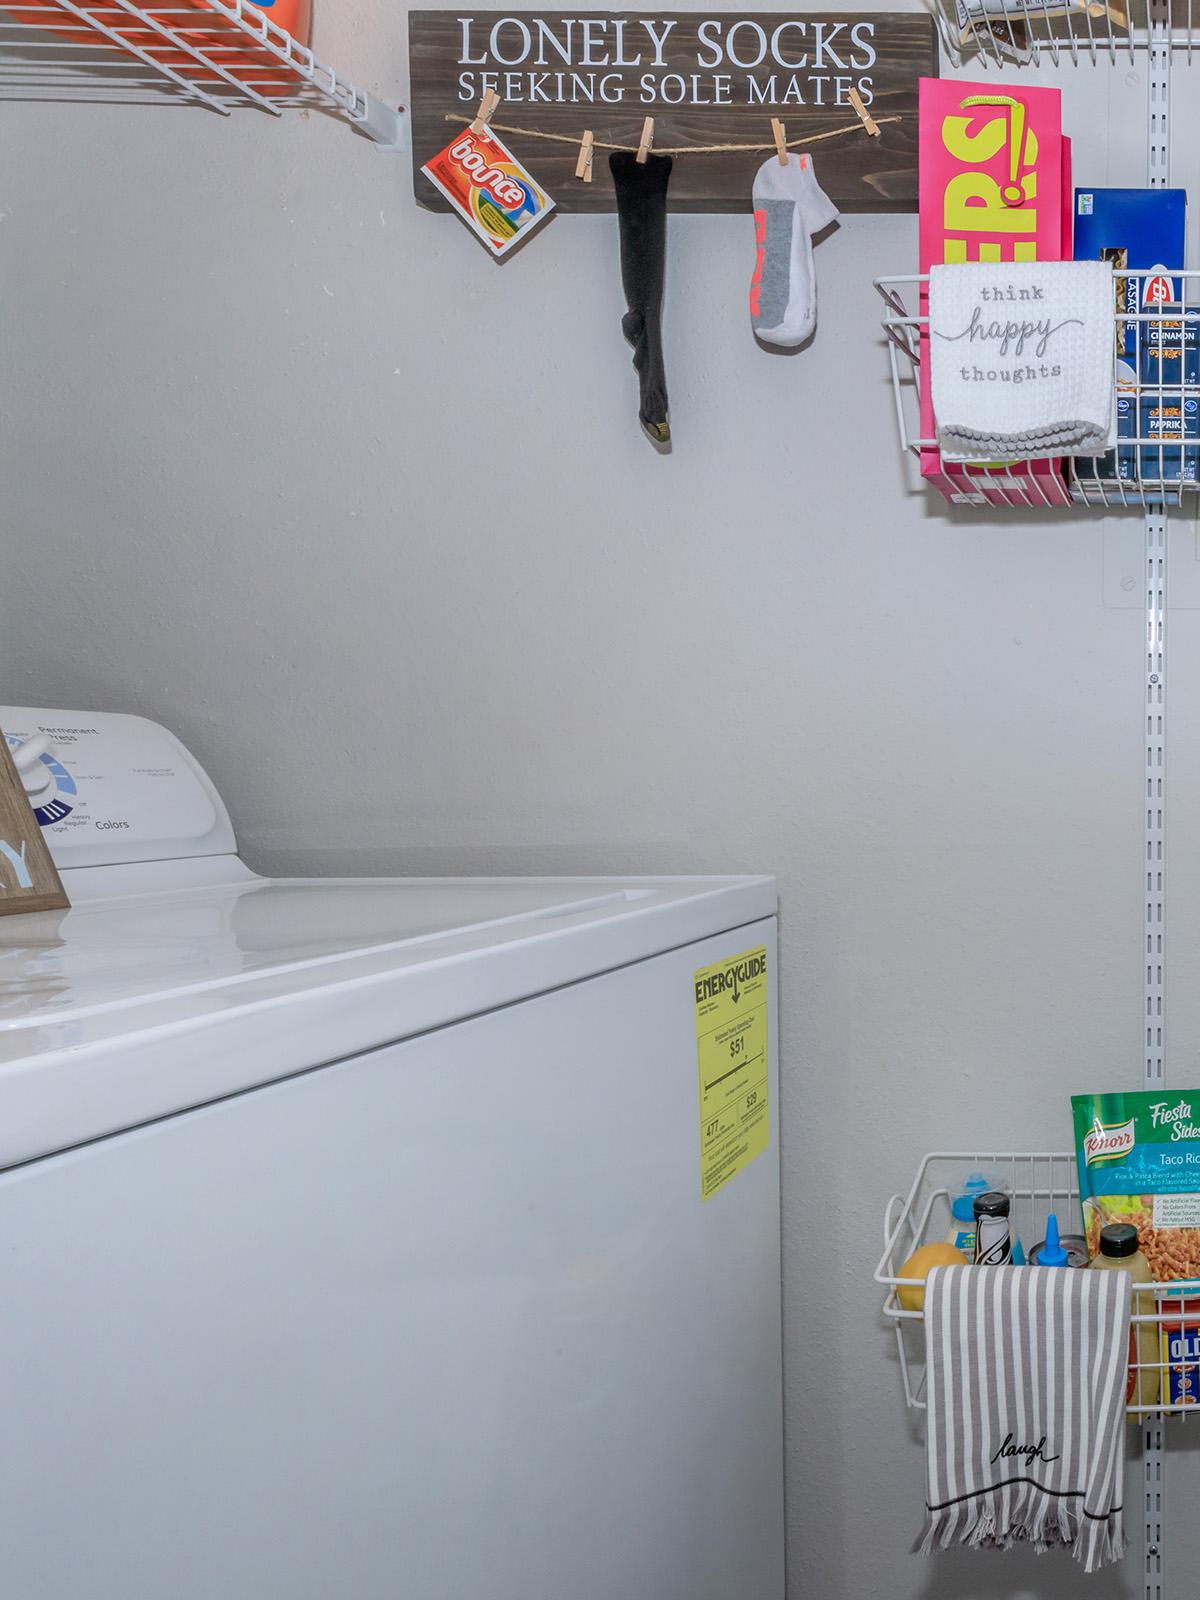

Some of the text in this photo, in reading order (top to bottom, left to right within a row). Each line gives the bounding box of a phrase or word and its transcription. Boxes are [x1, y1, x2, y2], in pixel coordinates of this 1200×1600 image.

[457, 18, 876, 70] LONELY SOCKS
[458, 71, 873, 106] SEEKING SOLE MATES
[450, 138, 523, 204] bounce
[980, 285, 1044, 301] think
[934, 306, 1084, 357] happy
[1150, 331, 1195, 340] CINAMON
[960, 364, 1062, 383] thoughts
[1150, 420, 1188, 430] PAPRIKA
[38, 726, 100, 735] Permanent
[95, 820, 130, 831] Colors
[695, 953, 767, 1004] ENERGYGUIDE
[730, 1036, 744, 1058] $51
[1149, 1100, 1192, 1129] Fiesta
[706, 1119, 719, 1138] 477
[1086, 1132, 1134, 1156] Knorr
[1160, 1153, 1184, 1165] Taco
[991, 1432, 1060, 1466] laugh
